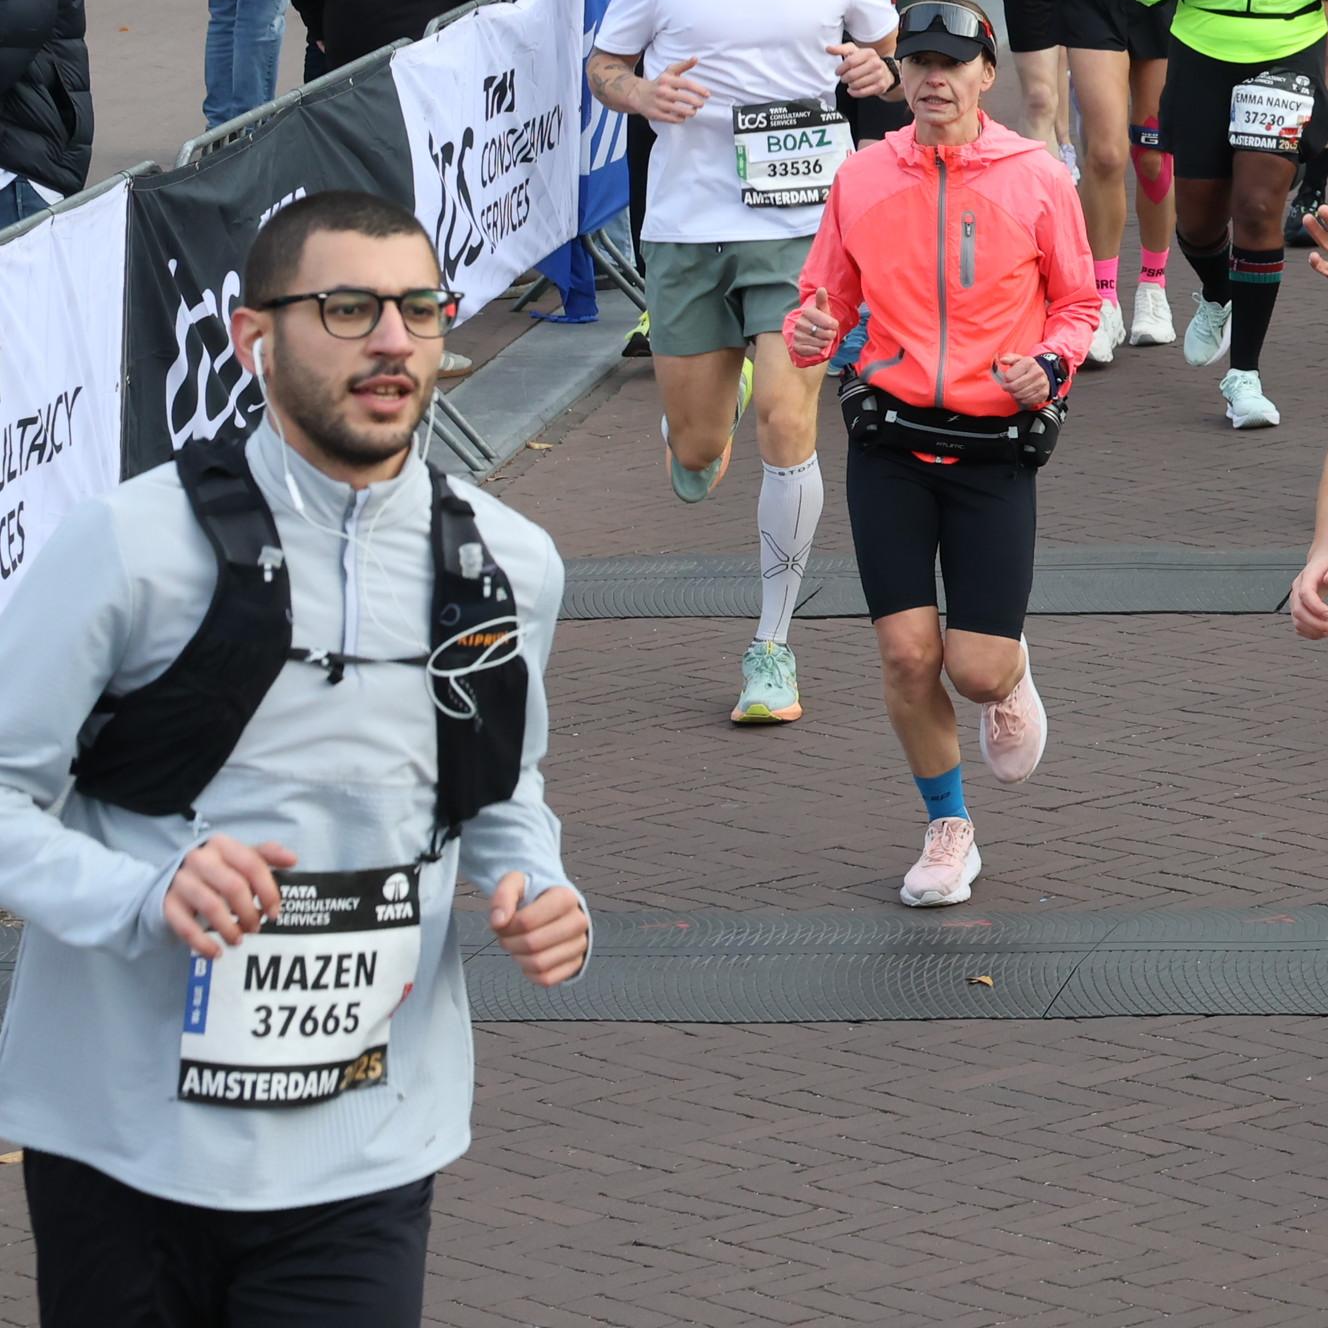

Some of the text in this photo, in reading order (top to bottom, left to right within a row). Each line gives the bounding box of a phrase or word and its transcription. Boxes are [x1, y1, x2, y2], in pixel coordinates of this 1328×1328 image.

[1235, 92, 1302, 112] EMMA NANCY
[738, 112, 767, 130] tcs
[1244, 110, 1285, 128] 37230
[766, 128, 833, 153] BOAZ
[766, 159, 824, 179] 33536
[280, 885, 317, 898] TATA
[278, 896, 361, 914] CONSULTANCY
[376, 902, 414, 922] TATA
[277, 911, 331, 926] SERVICES
[243, 950, 379, 993] MAZEN
[251, 1001, 361, 1039] 37665
[182, 1065, 340, 1103] AMSTERDAM
